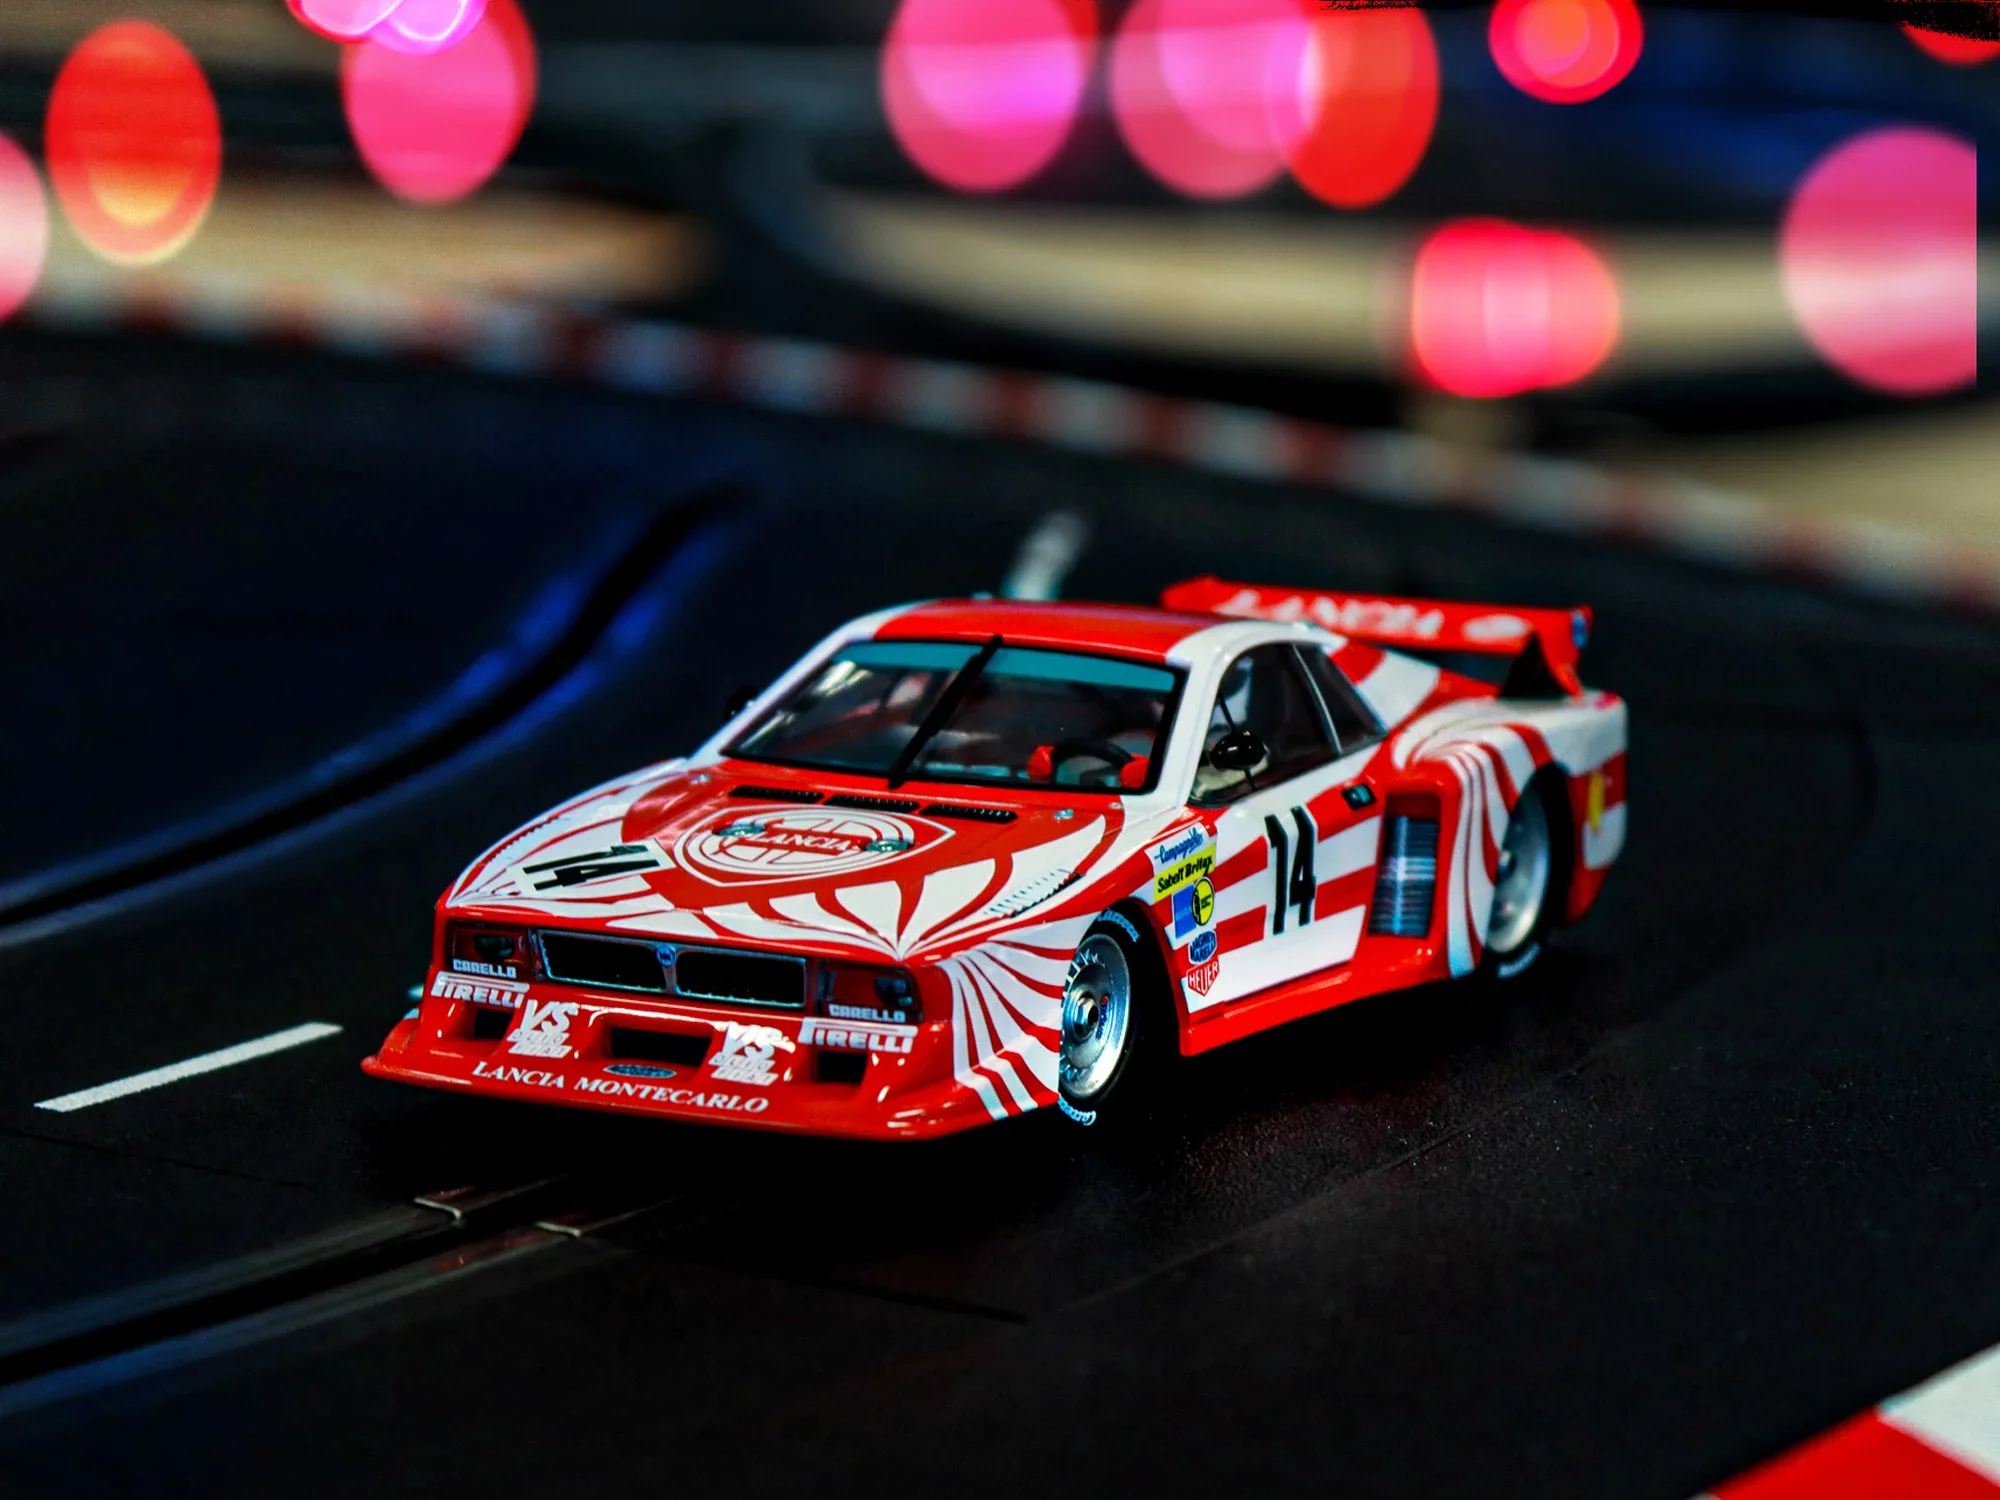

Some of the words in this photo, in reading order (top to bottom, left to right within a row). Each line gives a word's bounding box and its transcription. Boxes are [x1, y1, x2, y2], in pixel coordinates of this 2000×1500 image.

[746, 832, 851, 851] LANCIA
[522, 844, 661, 891] 14
[1264, 805, 1316, 936] 14
[453, 959, 517, 979] CARELLO
[1189, 961, 1219, 994] HEUER
[431, 971, 530, 1008] PIRELLI
[519, 1000, 579, 1034] VS
[828, 1003, 906, 1023] CARELLO
[798, 1017, 918, 1053] PIRELLI
[472, 1061, 565, 1088] LANCIA
[573, 1077, 769, 1113] MONTECARLO
